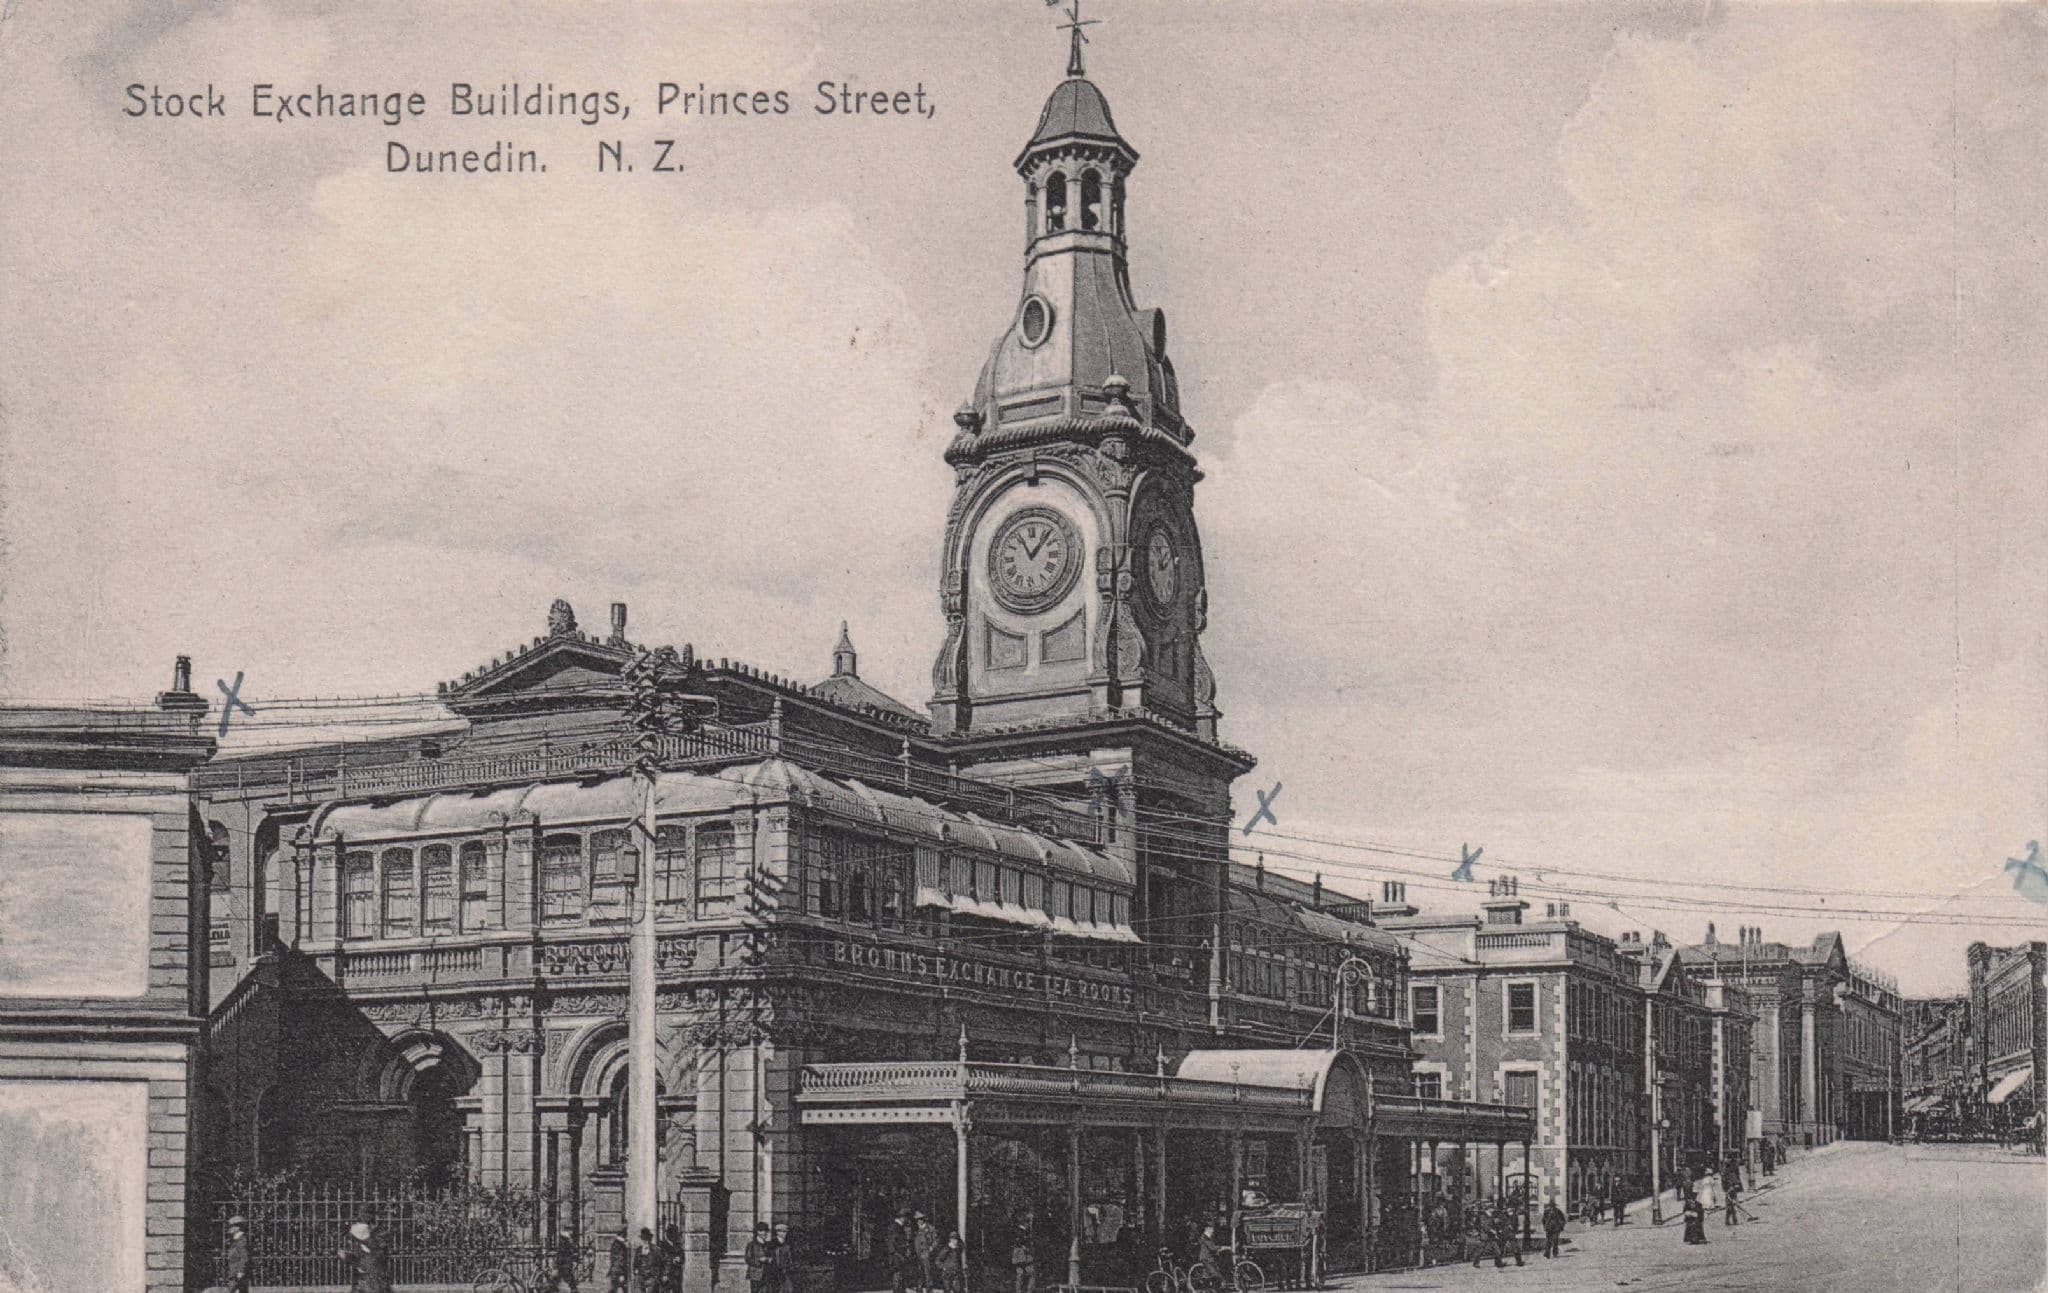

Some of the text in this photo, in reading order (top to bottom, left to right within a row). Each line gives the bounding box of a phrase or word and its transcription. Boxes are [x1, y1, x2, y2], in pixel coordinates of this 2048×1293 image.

[834, 940, 1131, 1004] BROWN'S EXCHANGE TEA ROOMS
